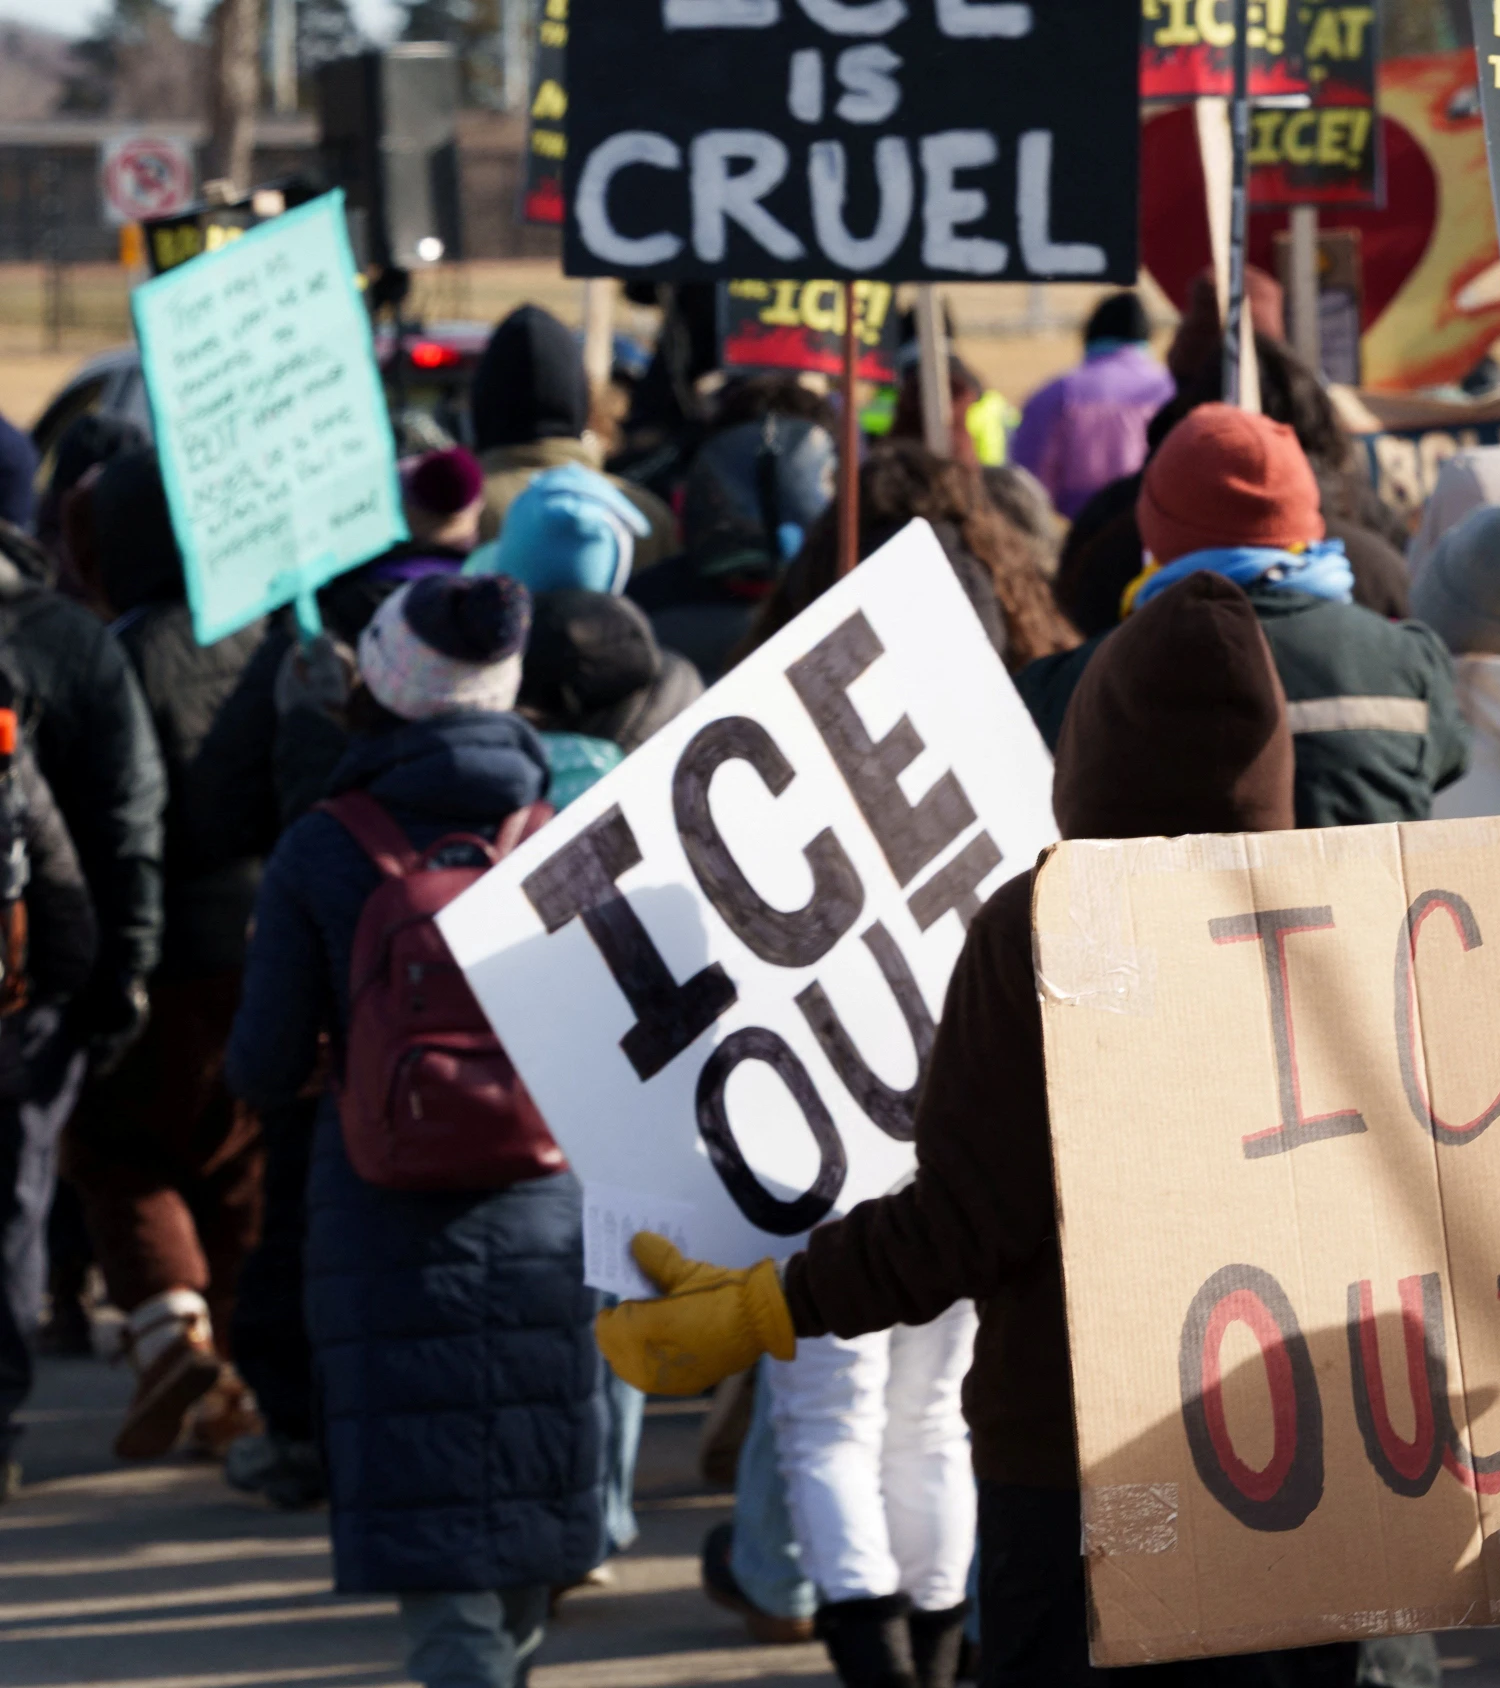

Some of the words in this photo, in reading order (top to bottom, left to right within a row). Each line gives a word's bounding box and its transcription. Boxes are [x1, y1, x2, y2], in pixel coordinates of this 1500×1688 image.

[788, 44, 902, 124] IS
[1247, 107, 1372, 170] ICE!
[574, 129, 1107, 275] CRUEL
[520, 607, 978, 1083] ICE
